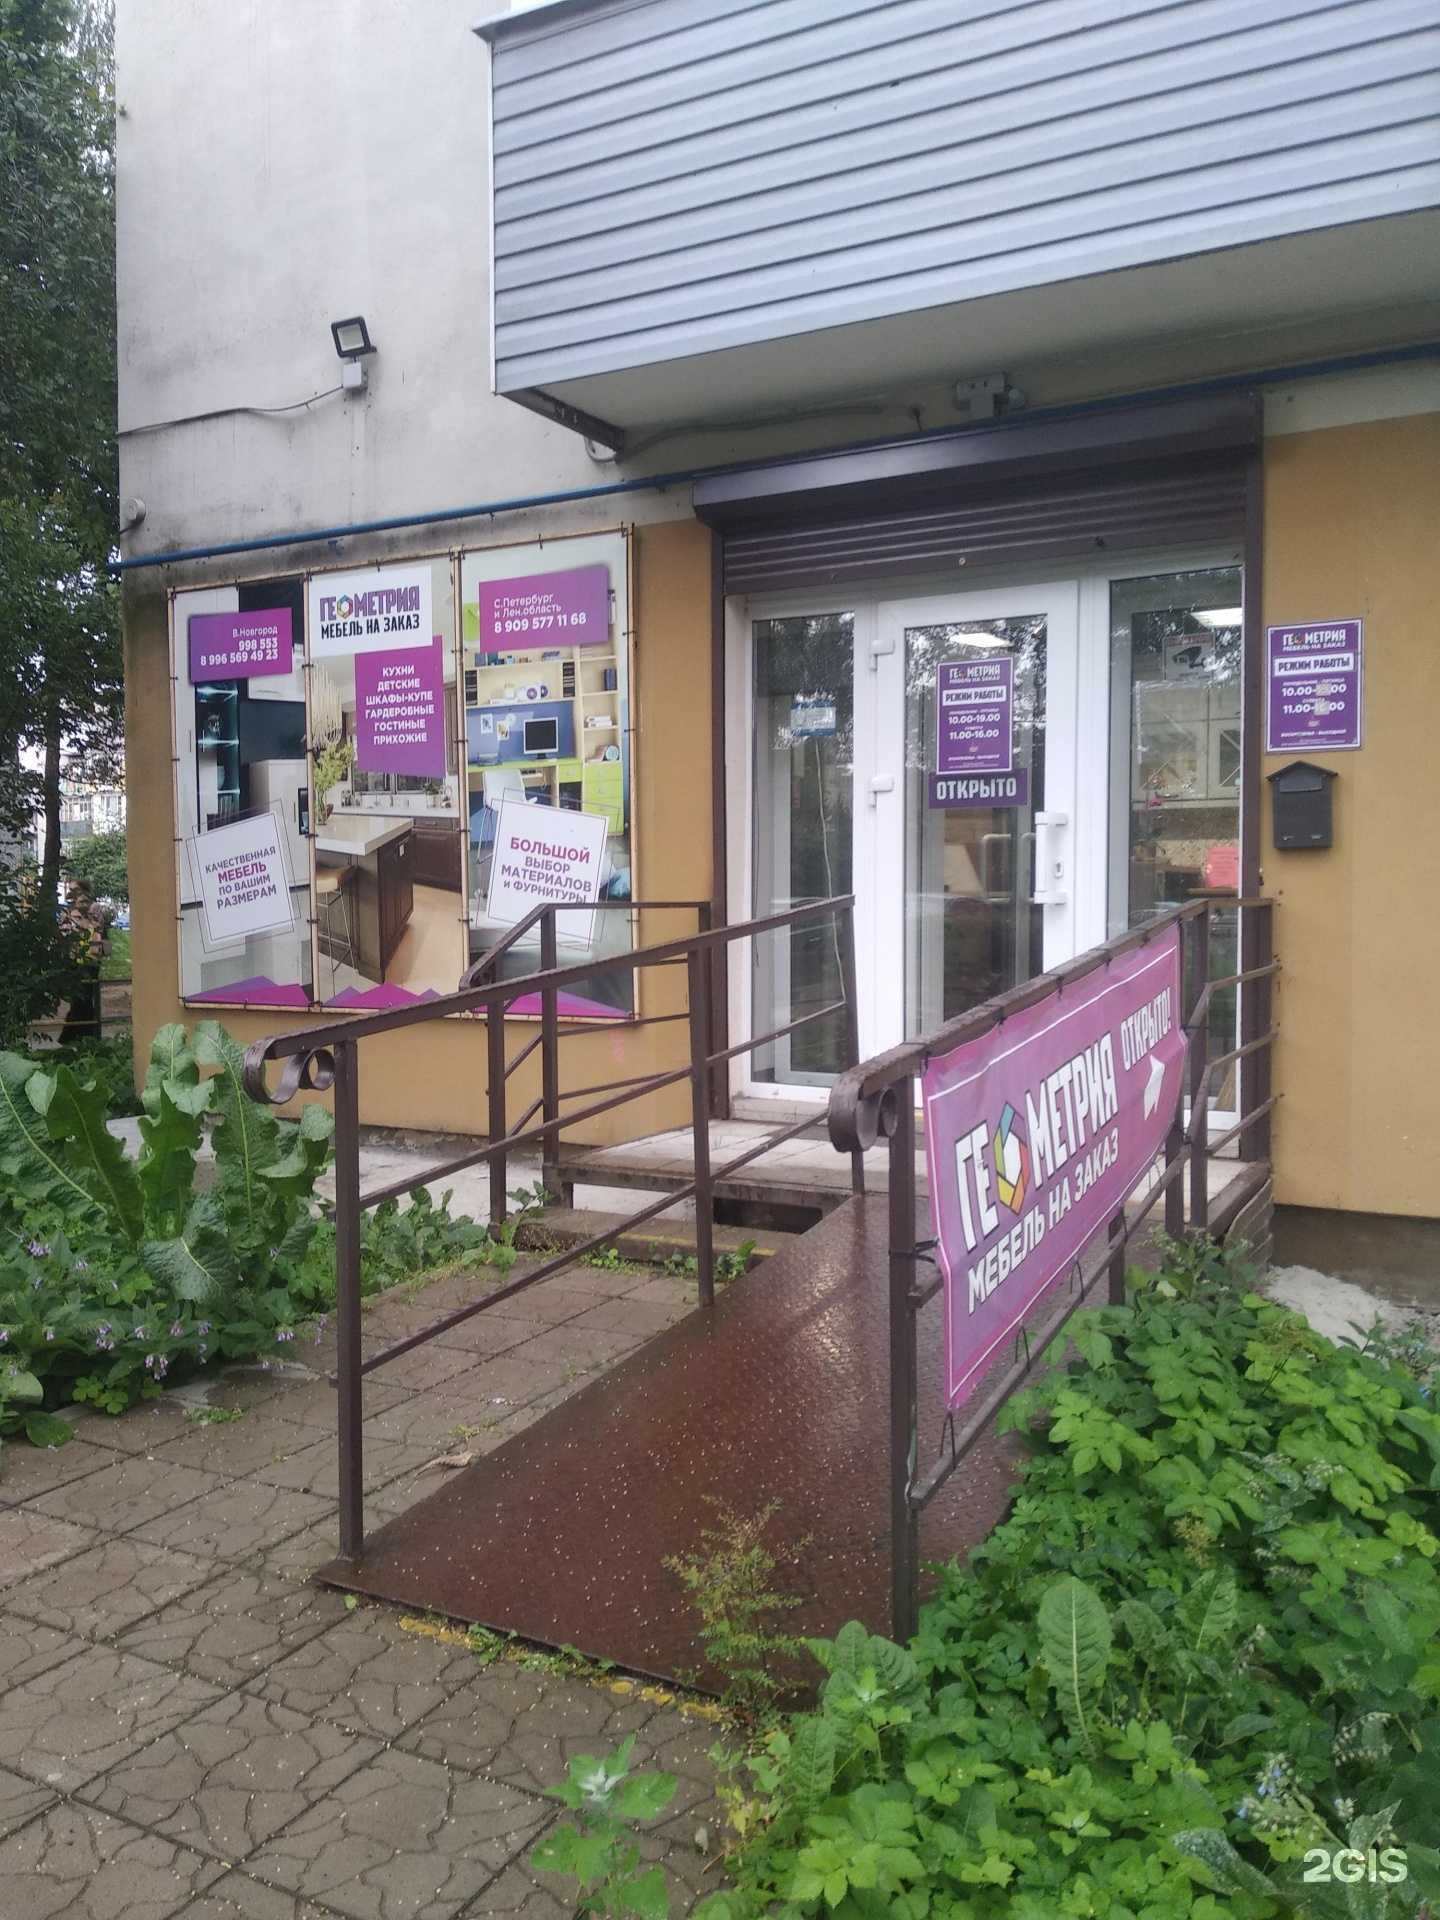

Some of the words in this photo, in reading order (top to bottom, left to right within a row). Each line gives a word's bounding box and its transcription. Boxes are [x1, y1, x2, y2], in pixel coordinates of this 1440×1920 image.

[320, 585, 420, 622] ГЕОМЕТРИЯ
[321, 622, 362, 640] МЕБЕЛЬ
[367, 618, 380, 633] НА
[384, 614, 420, 632] ЗАКАЗ
[494, 622, 501, 633] 8
[505, 619, 528, 632] 909
[532, 616, 553, 629] 577
[557, 614, 567, 626] 11
[571, 612, 587, 625] 68
[239, 640, 257, 651] 998
[260, 637, 278, 649] 553
[200, 656, 207, 666] 8
[230, 651, 248, 663] 569
[250, 650, 264, 661] 49
[266, 648, 278, 660] 23
[1279, 660, 1311, 672] РЕЖИМ
[1314, 657, 1350, 669] РАБОТЫ
[383, 665, 415, 678] КУХНИ
[378, 678, 420, 691] ДЕТСКИЕ
[366, 691, 433, 706] ШКАФЫ-КУПЕ
[945, 692, 972, 702] РЕЖИМ
[974, 689, 1003, 699] РАБОТЫ
[365, 704, 434, 719] ГАРДЕРОБНЫЕ
[948, 713, 1000, 725] 10.00-19.00
[374, 719, 425, 732] ГОСТИНЫЕ
[949, 729, 999, 740] 11.00-16.00
[373, 732, 427, 745] ПРИХОЖИЕ
[936, 778, 1016, 800] ОТКРЫТО
[205, 846, 276, 874] КАЧЕСТВЕННАЯ
[510, 837, 590, 864] БОЛЬШОЙ
[218, 862, 267, 884] МЕБЕЛЬ
[525, 856, 570, 873] ВЫБОР
[219, 886, 232, 896] ПО
[234, 874, 271, 891] ВАШИМ
[501, 864, 592, 892] МАТЕРИАЛОВ
[217, 884, 277, 909] РАЗМЕРАМ
[513, 880, 587, 904] ФУРНИТУРЫ
[1120, 987, 1170, 1072] ОТКРЫТО!
[967, 1203, 1046, 1317] МЕБЕЛЬ
[1049, 1177, 1072, 1231] НА
[1074, 1127, 1119, 1202] ЗАКАЗ
